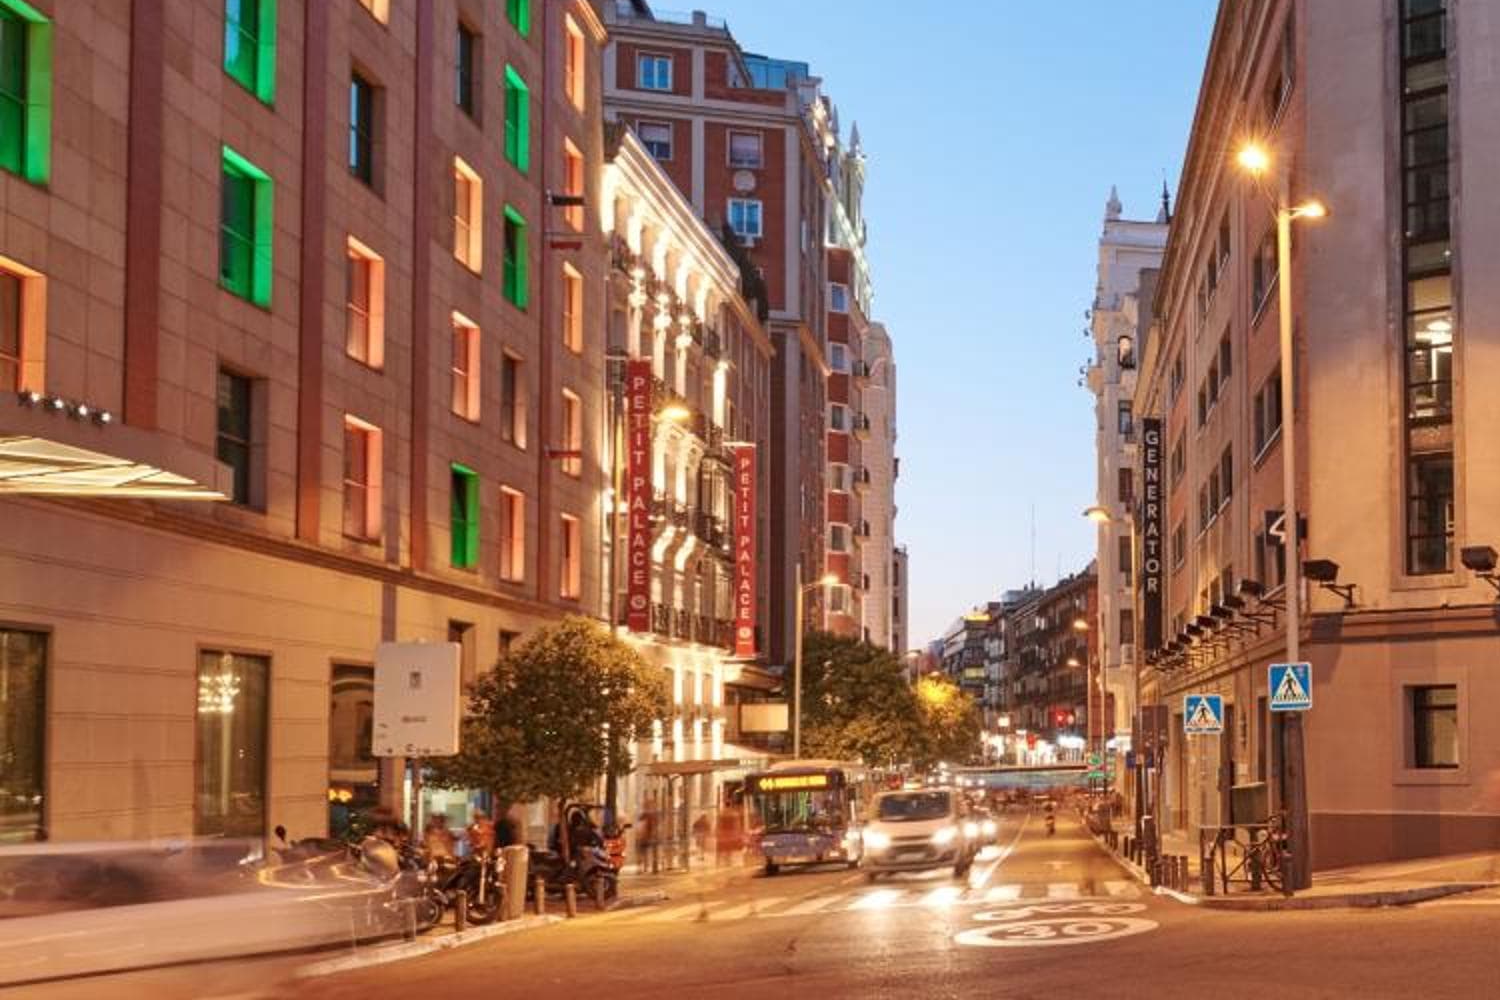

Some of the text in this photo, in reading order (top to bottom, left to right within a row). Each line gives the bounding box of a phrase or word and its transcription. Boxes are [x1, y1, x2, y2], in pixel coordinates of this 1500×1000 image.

[632, 376, 646, 586] PETIT PALACE
[740, 457, 751, 621] PETIT PALACE
[1144, 430, 1160, 593] GENERATOR
[1005, 920, 1115, 940] 30
